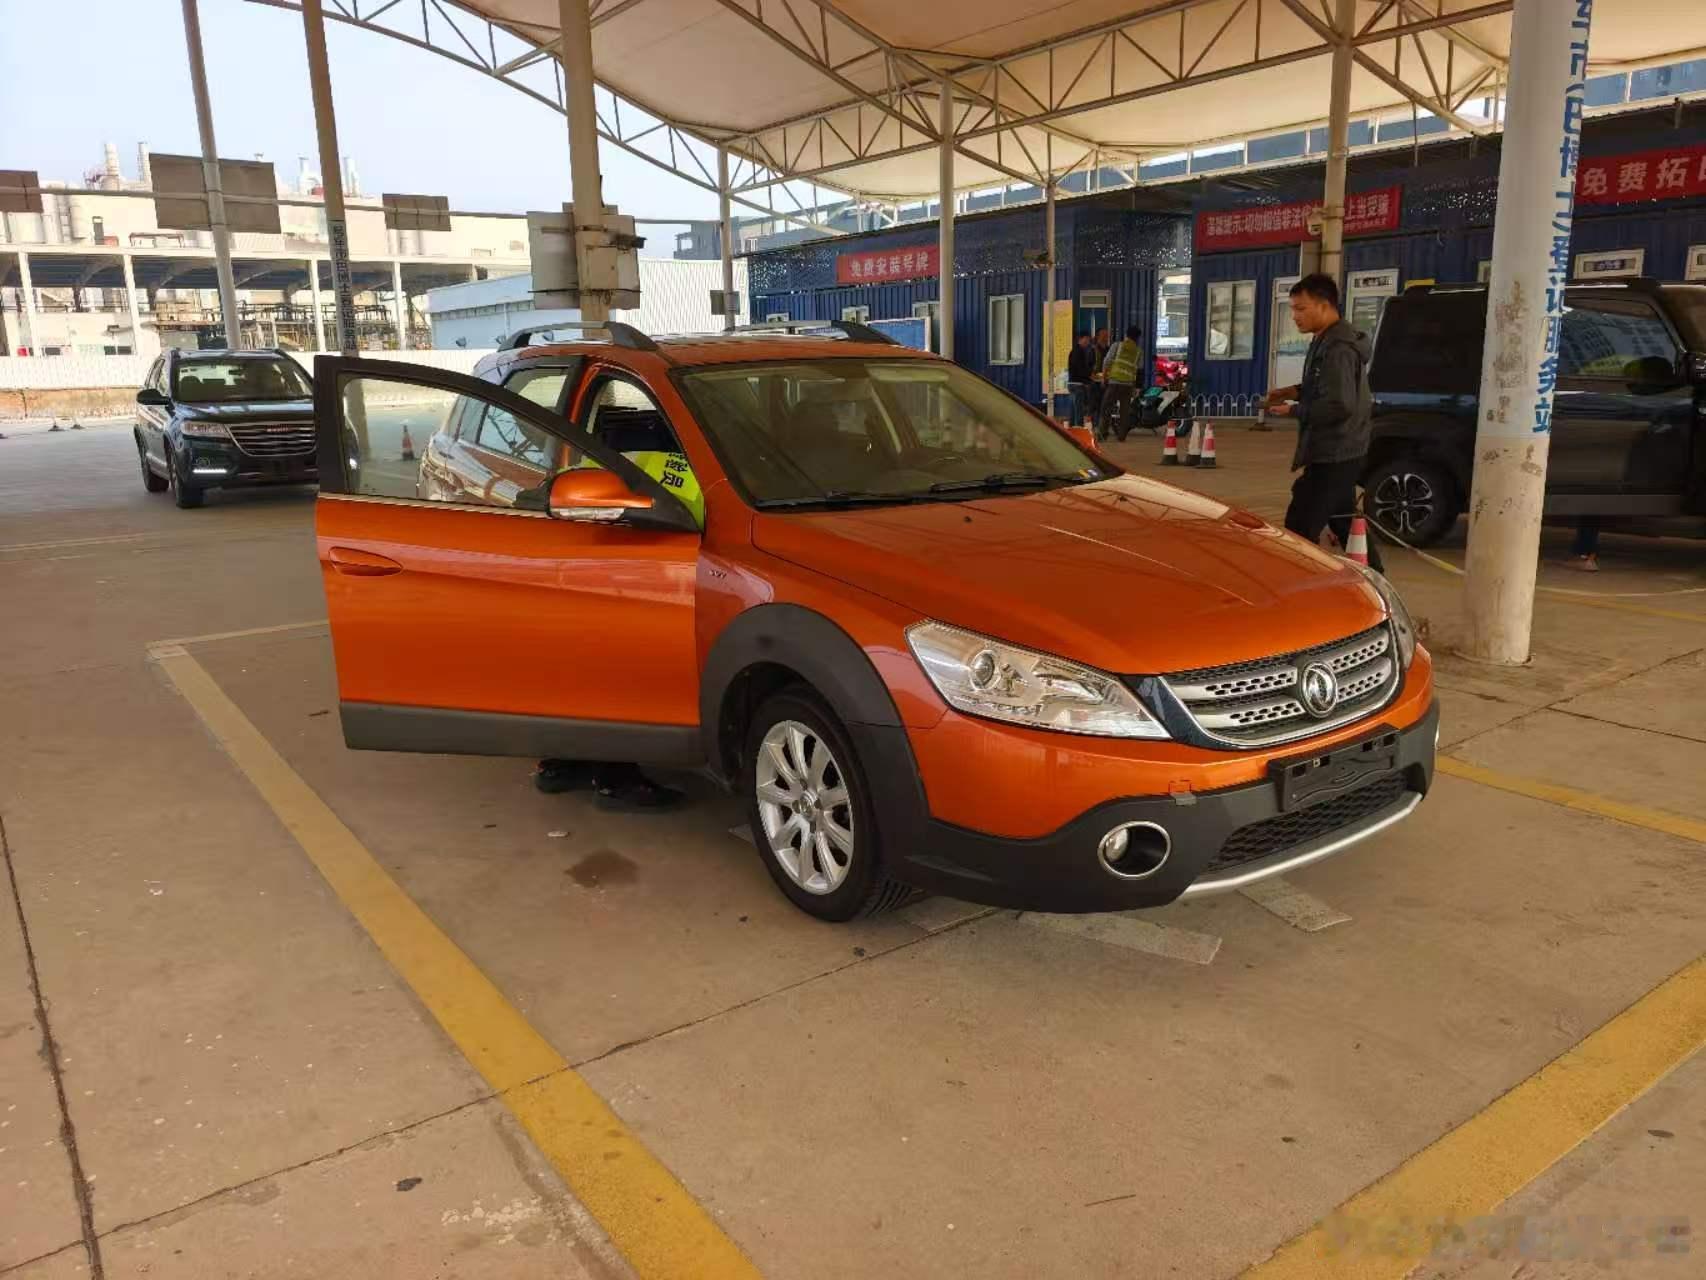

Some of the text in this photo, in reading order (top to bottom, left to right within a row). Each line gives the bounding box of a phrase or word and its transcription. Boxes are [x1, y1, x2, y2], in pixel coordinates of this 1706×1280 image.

[850, 251, 929, 277] 免费安装号牌
